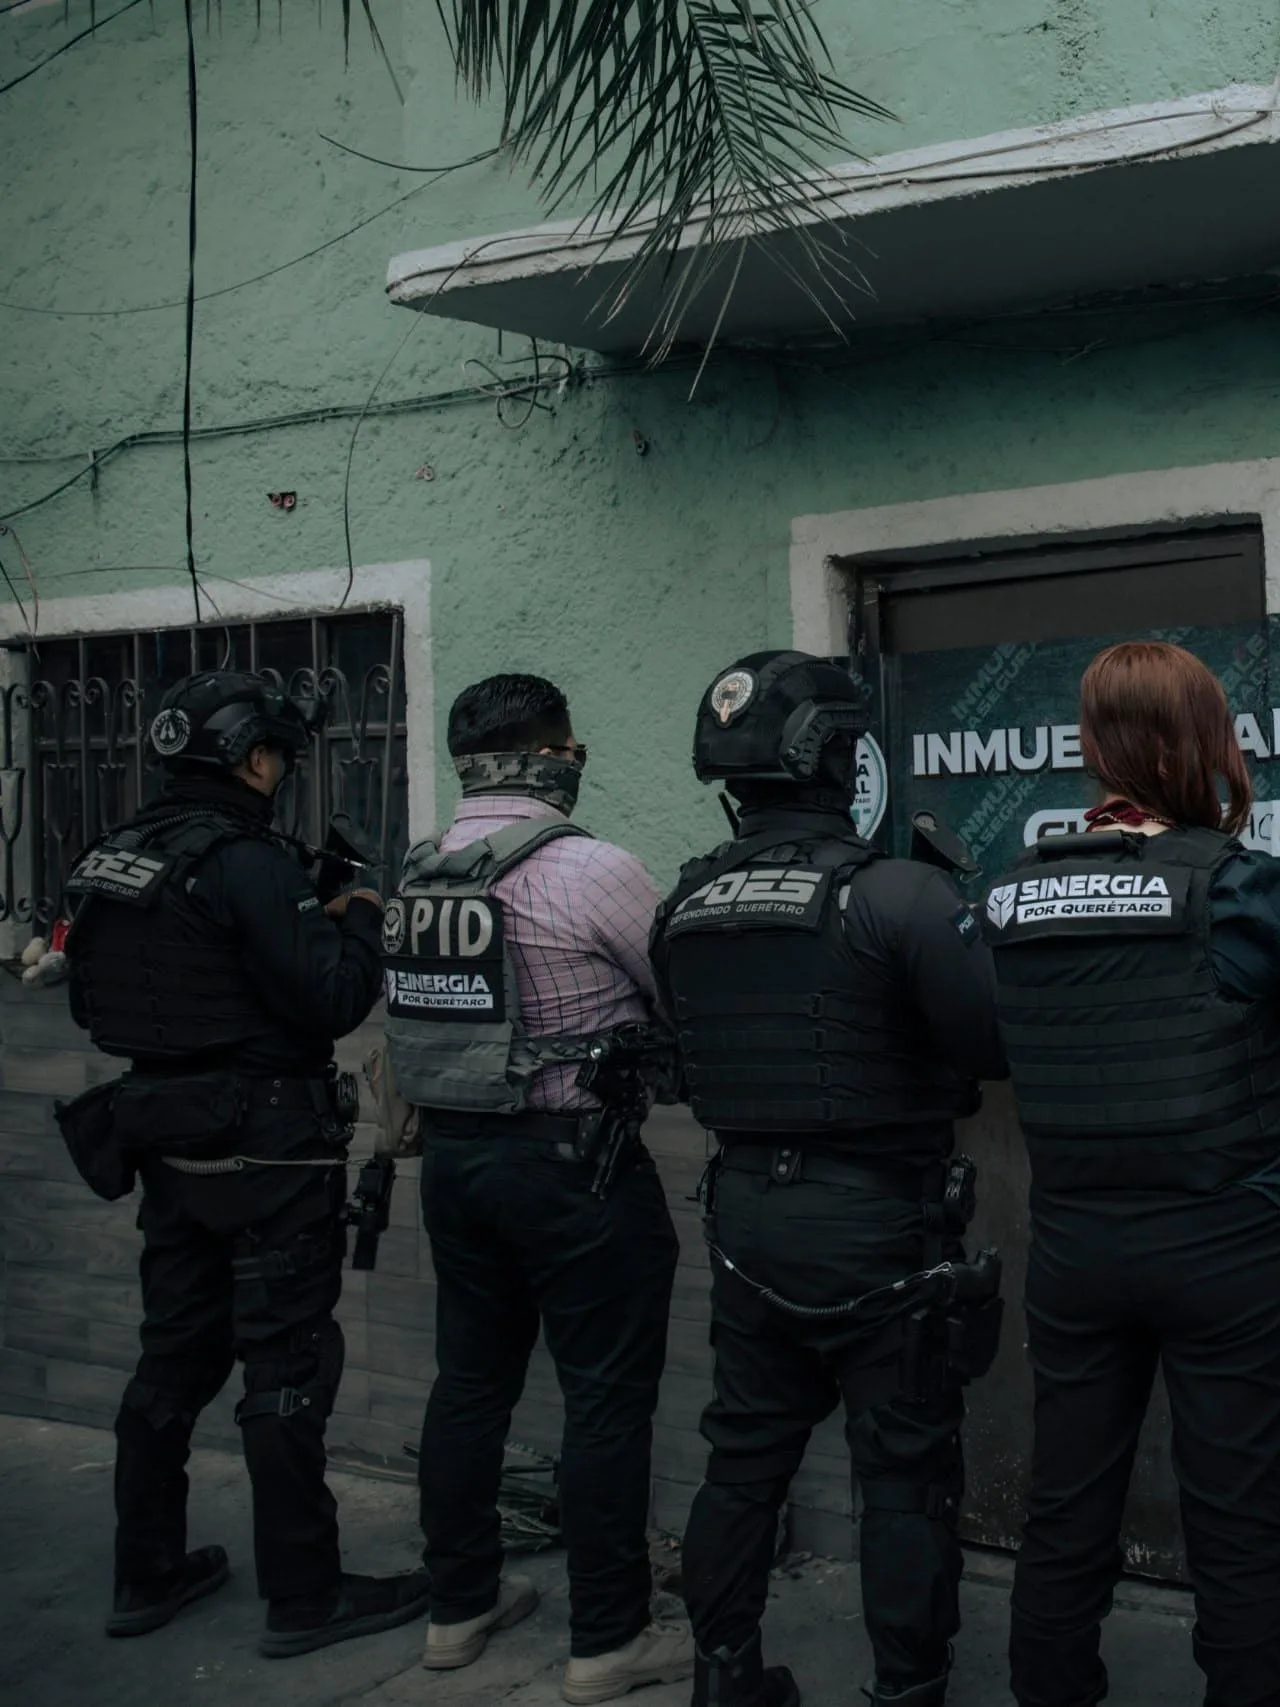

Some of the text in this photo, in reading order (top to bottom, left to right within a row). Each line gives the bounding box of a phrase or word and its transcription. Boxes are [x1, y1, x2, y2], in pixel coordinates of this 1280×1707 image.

[951, 642, 1017, 721] INMUE
[912, 724, 1085, 776] INMUE
[1019, 873, 1169, 902] SINERGIA
[735, 901, 805, 915] QUERÉTARO
[1024, 901, 1162, 918] POR QUERÉTARO
[410, 898, 493, 956] PID
[397, 971, 490, 993] SINERGIA
[402, 995, 421, 1004] POR
